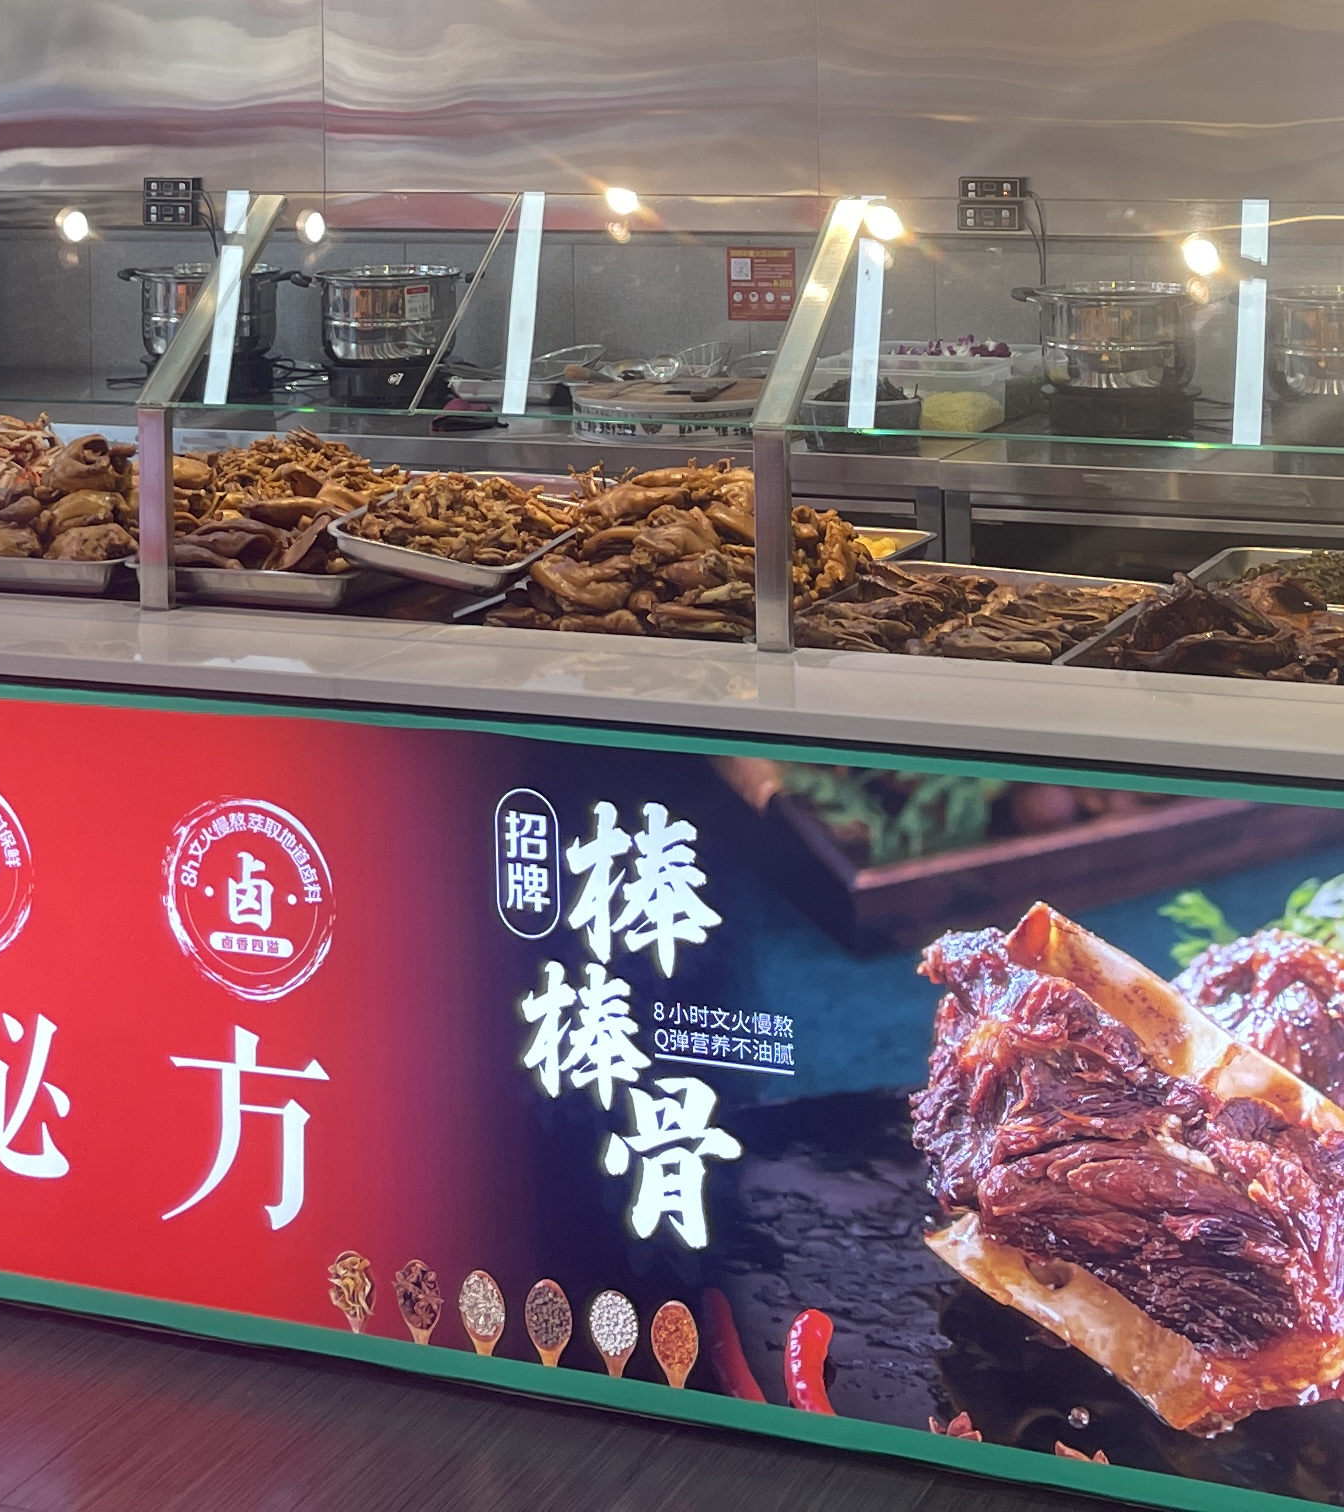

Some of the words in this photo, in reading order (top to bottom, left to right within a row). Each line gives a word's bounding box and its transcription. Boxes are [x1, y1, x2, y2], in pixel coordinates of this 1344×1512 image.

[505, 809, 551, 913] 招牌
[228, 851, 274, 932] 卤
[221, 935, 279, 954] 卤香四溢
[521, 801, 744, 1249] 棒棒骨
[653, 1000, 795, 1039] 8小时文火慢熬
[653, 1029, 796, 1069] Q弹营养不油腻
